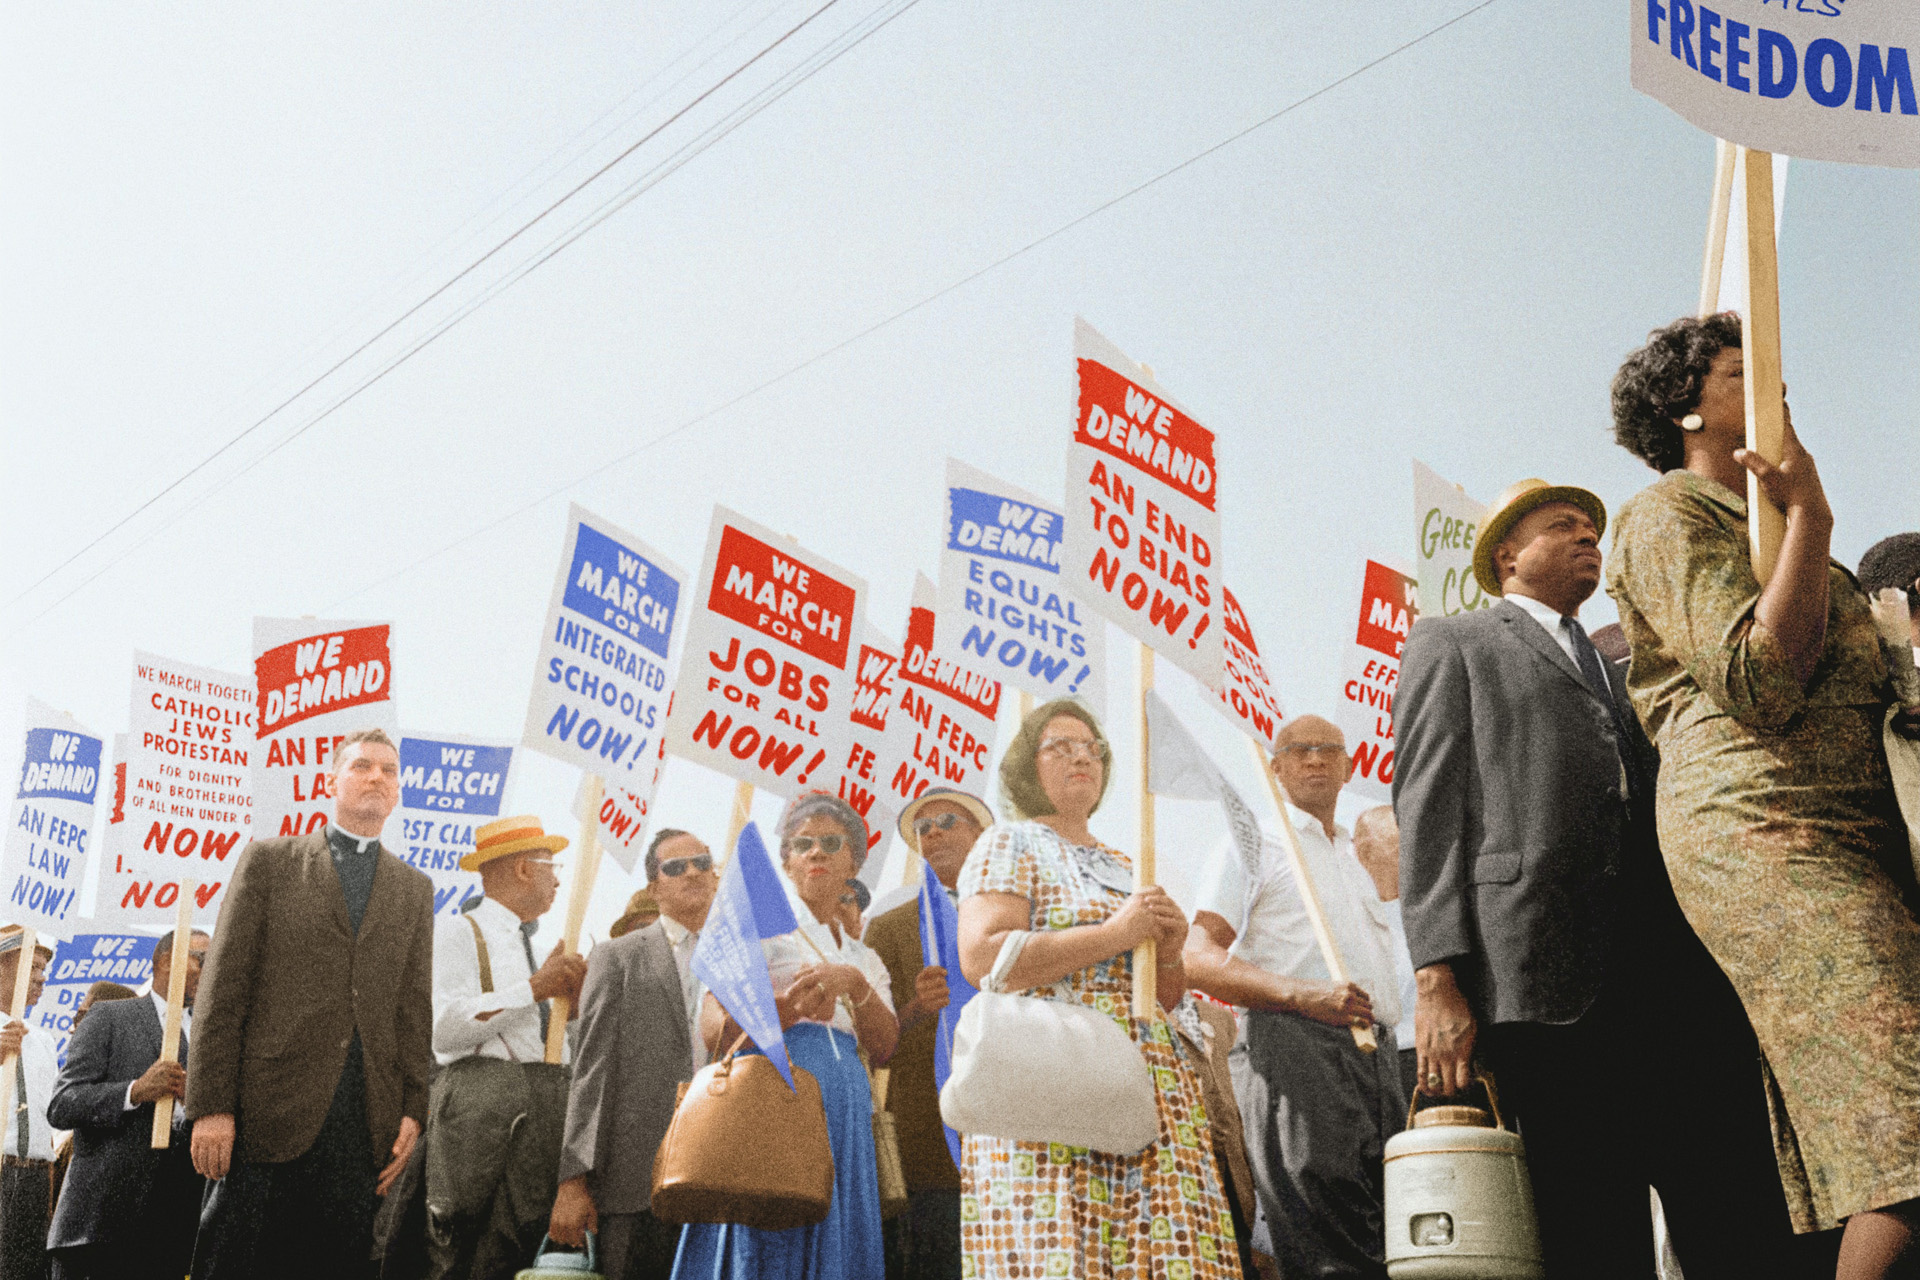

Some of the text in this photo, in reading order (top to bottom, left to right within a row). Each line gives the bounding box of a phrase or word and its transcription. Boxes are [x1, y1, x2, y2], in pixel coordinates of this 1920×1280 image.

[1647, 0, 1919, 116] FREEDOM
[1124, 384, 1175, 436] WE
[1085, 402, 1214, 494] DEMAND
[997, 500, 1055, 536] WE
[1088, 458, 1212, 569] AN END
[1421, 507, 1477, 559] GREE
[617, 549, 650, 590] WE
[1089, 494, 1212, 608] TO BIAS
[771, 554, 811, 594] WE
[968, 558, 1083, 627] EQUAL
[1442, 564, 1490, 617] CO
[576, 560, 670, 635] MARCH
[723, 563, 843, 643] MARCH
[1088, 545, 1212, 651] NOW!
[1368, 596, 1420, 638] MA
[603, 606, 642, 639] FOR
[758, 612, 804, 645] FOR
[964, 587, 1087, 658] RIGHTS
[294, 635, 344, 678] WE
[554, 615, 666, 694] INTEGRATED
[708, 636, 831, 713] JOBS
[906, 644, 998, 707] DEMAND
[960, 623, 1092, 694] NOW!
[1362, 659, 1399, 688] EFF
[137, 664, 154, 682] WE
[158, 670, 201, 693] MARCH
[264, 659, 386, 726] DEMAND
[547, 656, 658, 731] SCHOOLS
[707, 676, 820, 737] FOR ALL
[899, 686, 989, 772] AN FEPC
[50, 732, 81, 762] WE
[143, 731, 248, 767] PROTESTAN
[169, 717, 232, 744] JEWS
[265, 737, 306, 768] AN
[546, 703, 648, 771] NOW!
[692, 708, 827, 785] NOW!
[23, 761, 96, 795] DEMAND
[159, 763, 242, 788] FOR DIGNITY
[440, 746, 476, 769] WE
[846, 741, 877, 783] FE
[913, 731, 966, 784] LAW
[137, 778, 162, 794] AND
[401, 764, 500, 797] MARCH
[425, 794, 466, 811] FOR
[18, 804, 88, 854] AN FEPC
[132, 795, 145, 808] OF
[149, 799, 166, 813] ALL
[170, 803, 194, 818] MEN
[199, 808, 238, 824] UNDER
[143, 820, 253, 862] NOW
[438, 823, 477, 847] CLA
[28, 842, 71, 880] LAW
[10, 873, 76, 921] NOW!
[91, 936, 138, 958] WE
